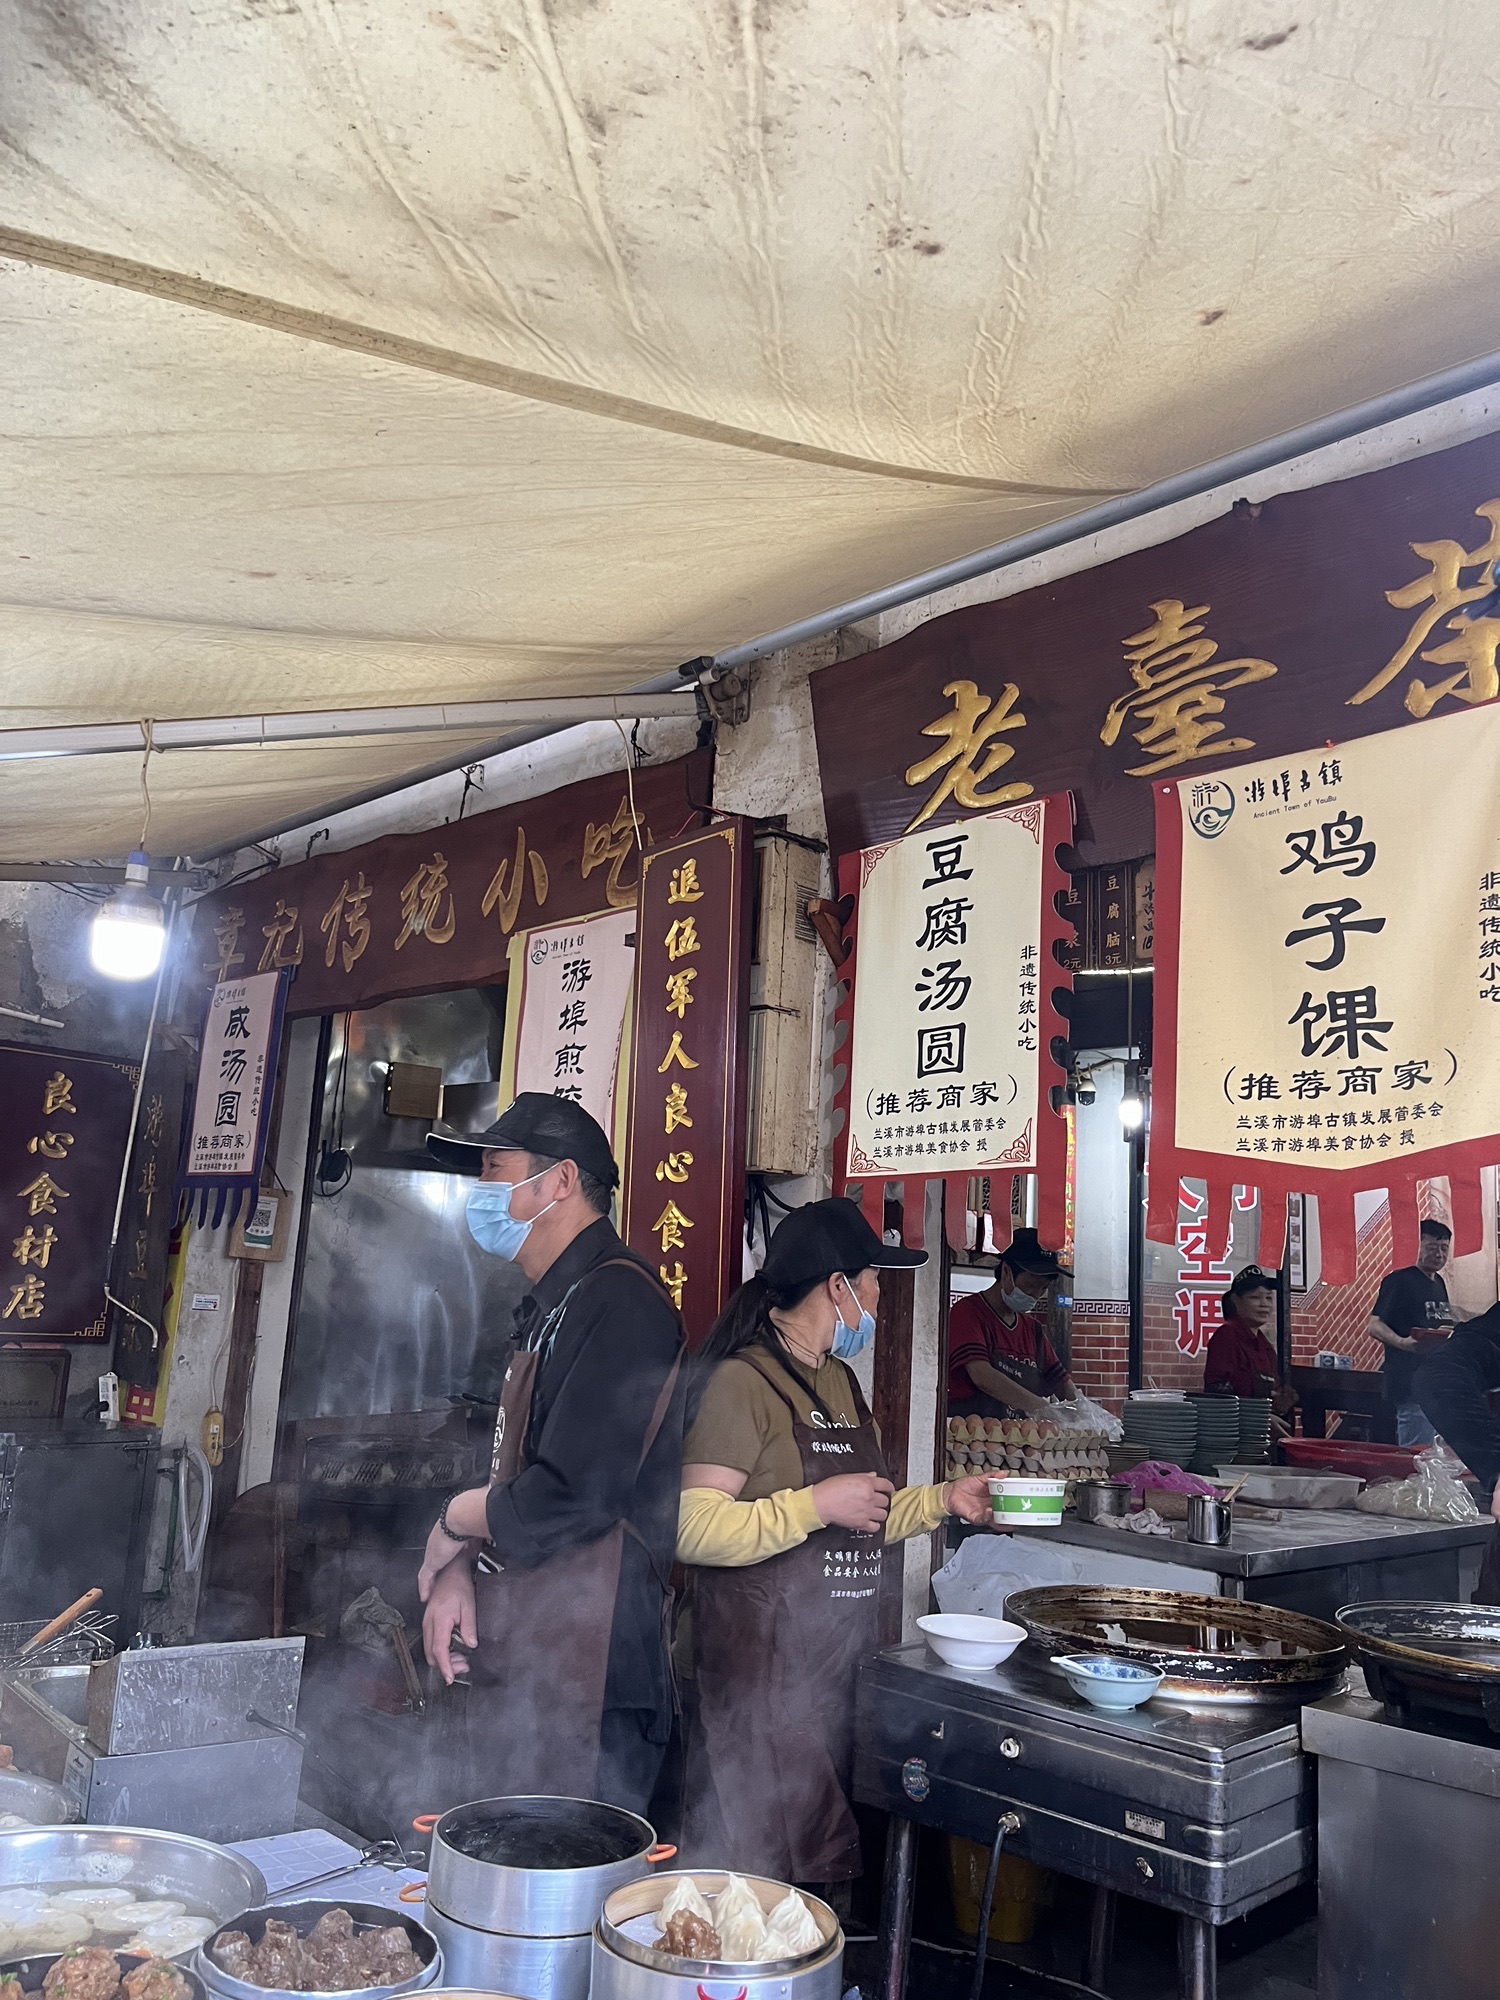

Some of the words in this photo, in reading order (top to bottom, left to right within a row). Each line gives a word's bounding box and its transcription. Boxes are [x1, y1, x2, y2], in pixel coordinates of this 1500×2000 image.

[1253, 808, 1280, 819] Ancient
[1284, 804, 1300, 812] Town
[1315, 795, 1337, 805] YouBu
[1106, 875, 1121, 949] 豆腐脑
[1280, 811, 1393, 1060] 鸡子馃
[1479, 871, 1500, 1003] 非遗传统小吃
[914, 834, 974, 1079] 豆腐汤圆
[1063, 957, 1082, 970] 2元
[1105, 952, 1121, 965] 3元
[1017, 945, 1038, 1052] 非遗传统小吃
[215, 1006, 251, 1128] 咸汤圆
[1223, 1047, 1458, 1105] （推荐商家）
[866, 1073, 1018, 1121] （推荐商家）
[1236, 1101, 1444, 1130] 兰溪市游埠古镇发展管委会
[873, 1141, 971, 1159] 兰溪市游埠美食协会
[976, 1138, 988, 1152] 授
[1236, 1132, 1392, 1152] 兰溪市游埠美食协会
[1399, 1128, 1415, 1146] 授
[2, 1071, 77, 1320] 良心食材店
